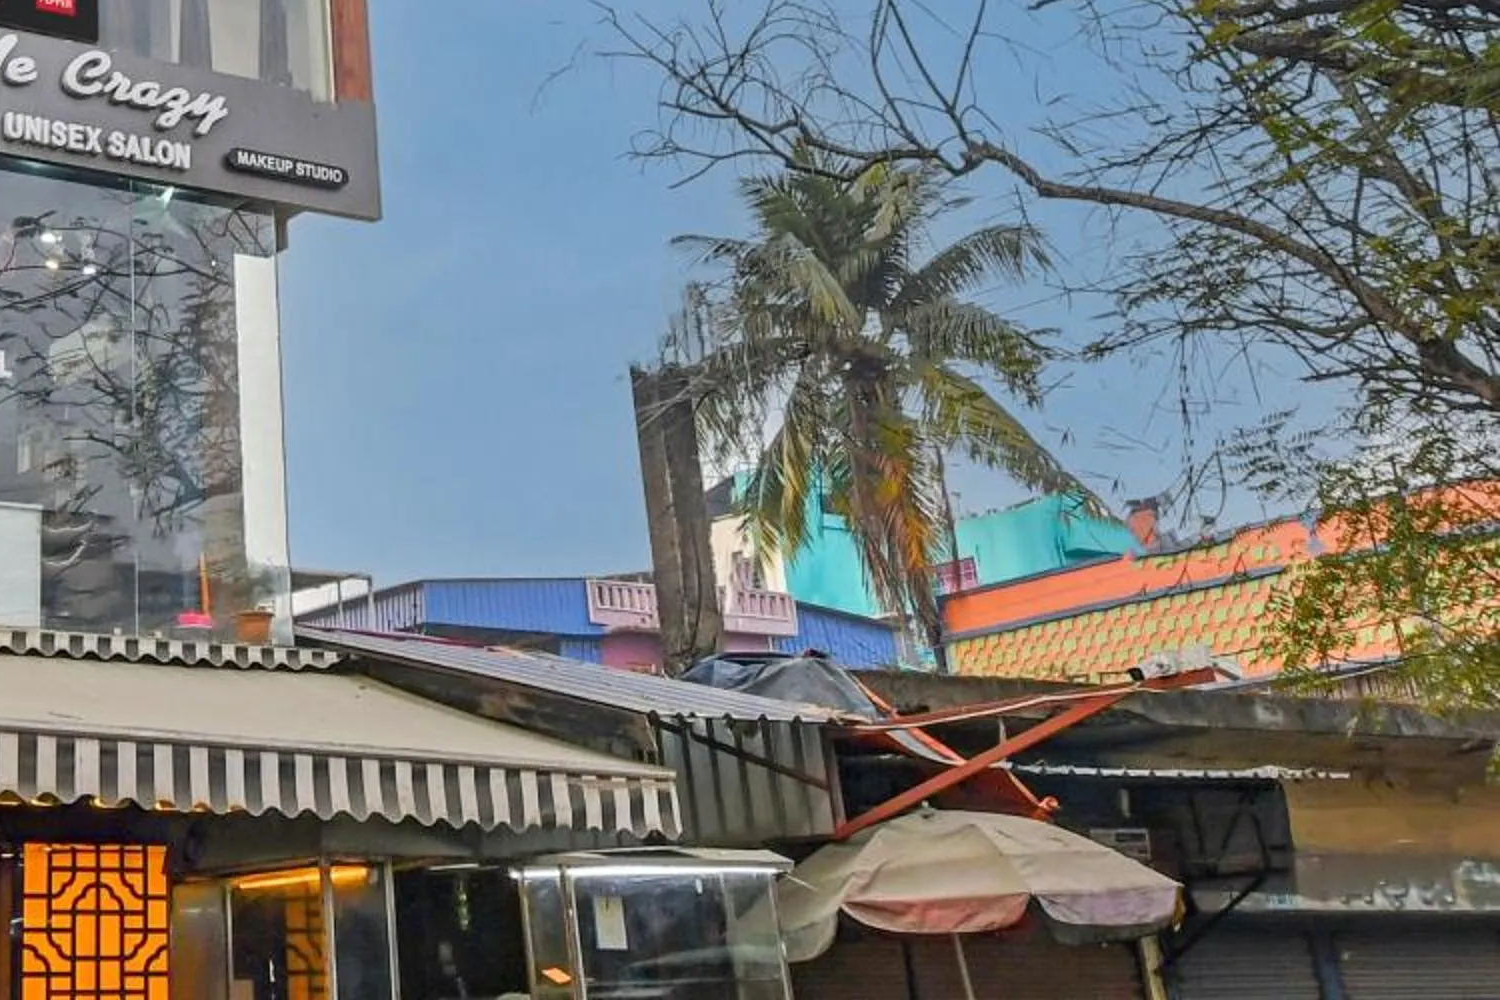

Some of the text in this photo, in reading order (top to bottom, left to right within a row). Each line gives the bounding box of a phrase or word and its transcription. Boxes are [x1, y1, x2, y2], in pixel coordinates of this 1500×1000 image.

[62, 50, 229, 135] Crazy
[3, 111, 103, 154] UNISEX
[107, 131, 192, 170] SALON
[237, 151, 343, 184] MAKEUP STUDIO
